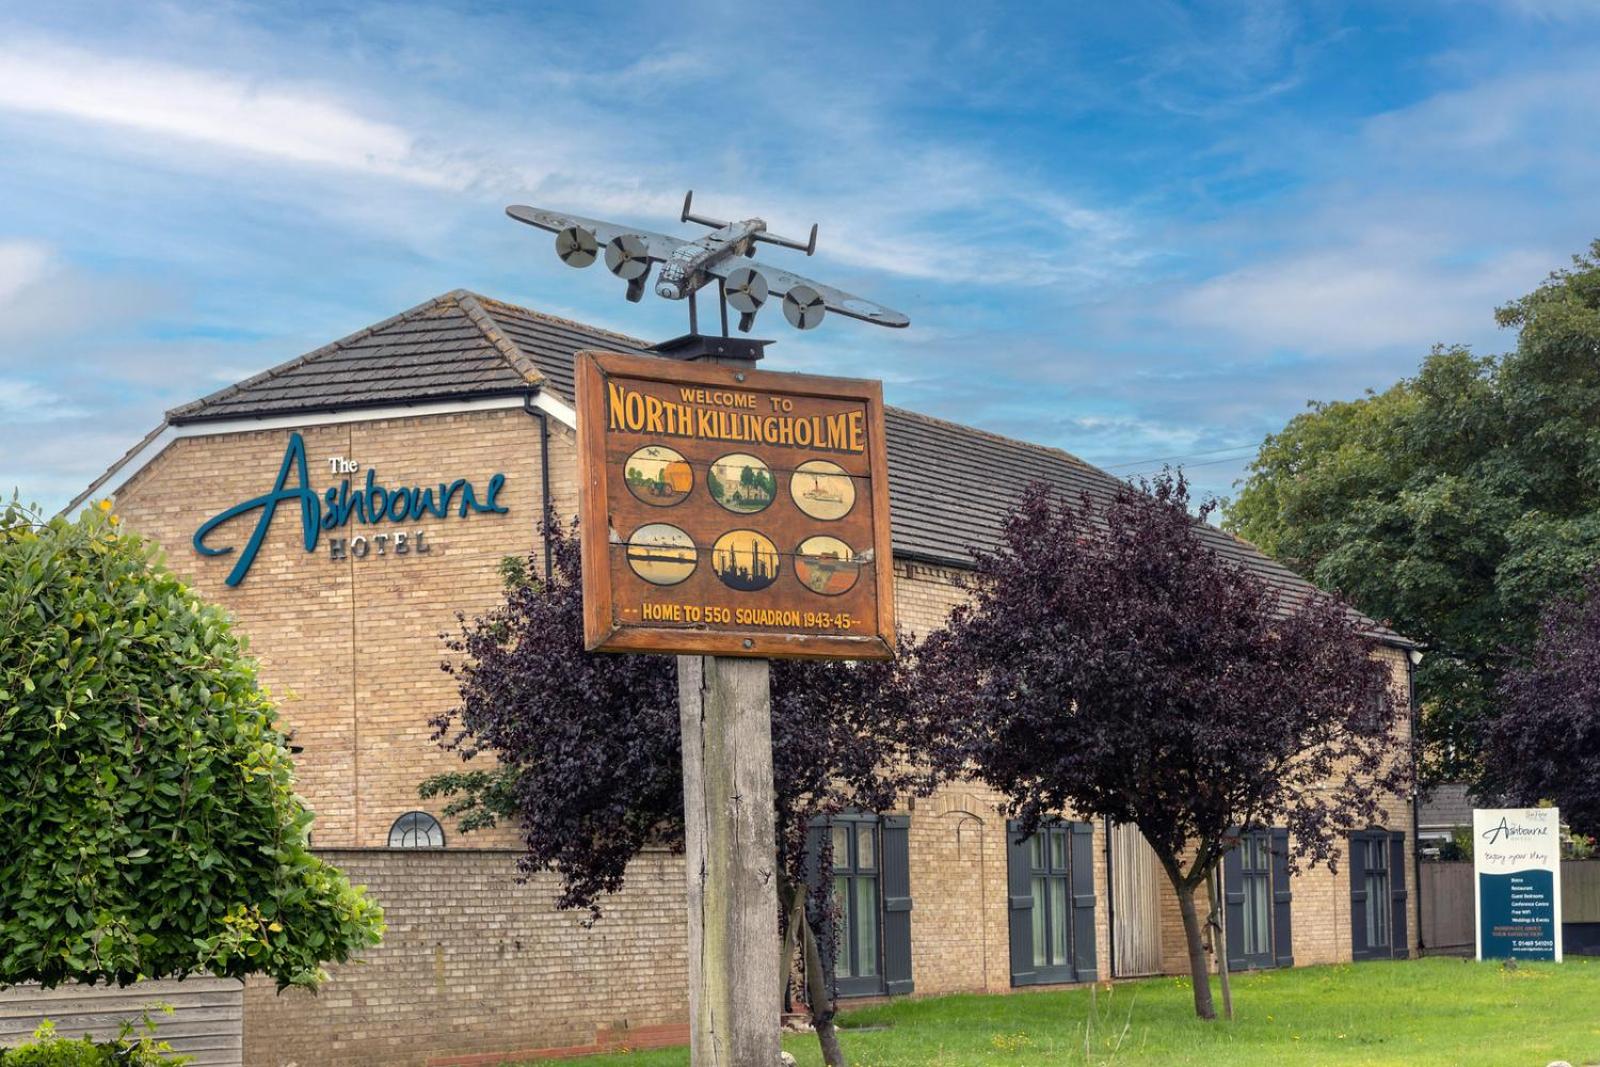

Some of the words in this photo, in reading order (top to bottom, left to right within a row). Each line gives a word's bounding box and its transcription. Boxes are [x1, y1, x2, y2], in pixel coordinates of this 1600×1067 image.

[680, 388, 757, 409] WELCOME
[770, 397, 793, 412] TO
[607, 381, 694, 438] NORTH
[697, 407, 866, 453] KILLINGHOLME
[328, 457, 359, 475] The
[192, 431, 510, 588] Ashbourne
[329, 530, 432, 561] HOTEL
[642, 602, 681, 622] HOME
[683, 604, 701, 623] TO
[704, 606, 731, 624] 550
[735, 607, 800, 628] SQUADRON
